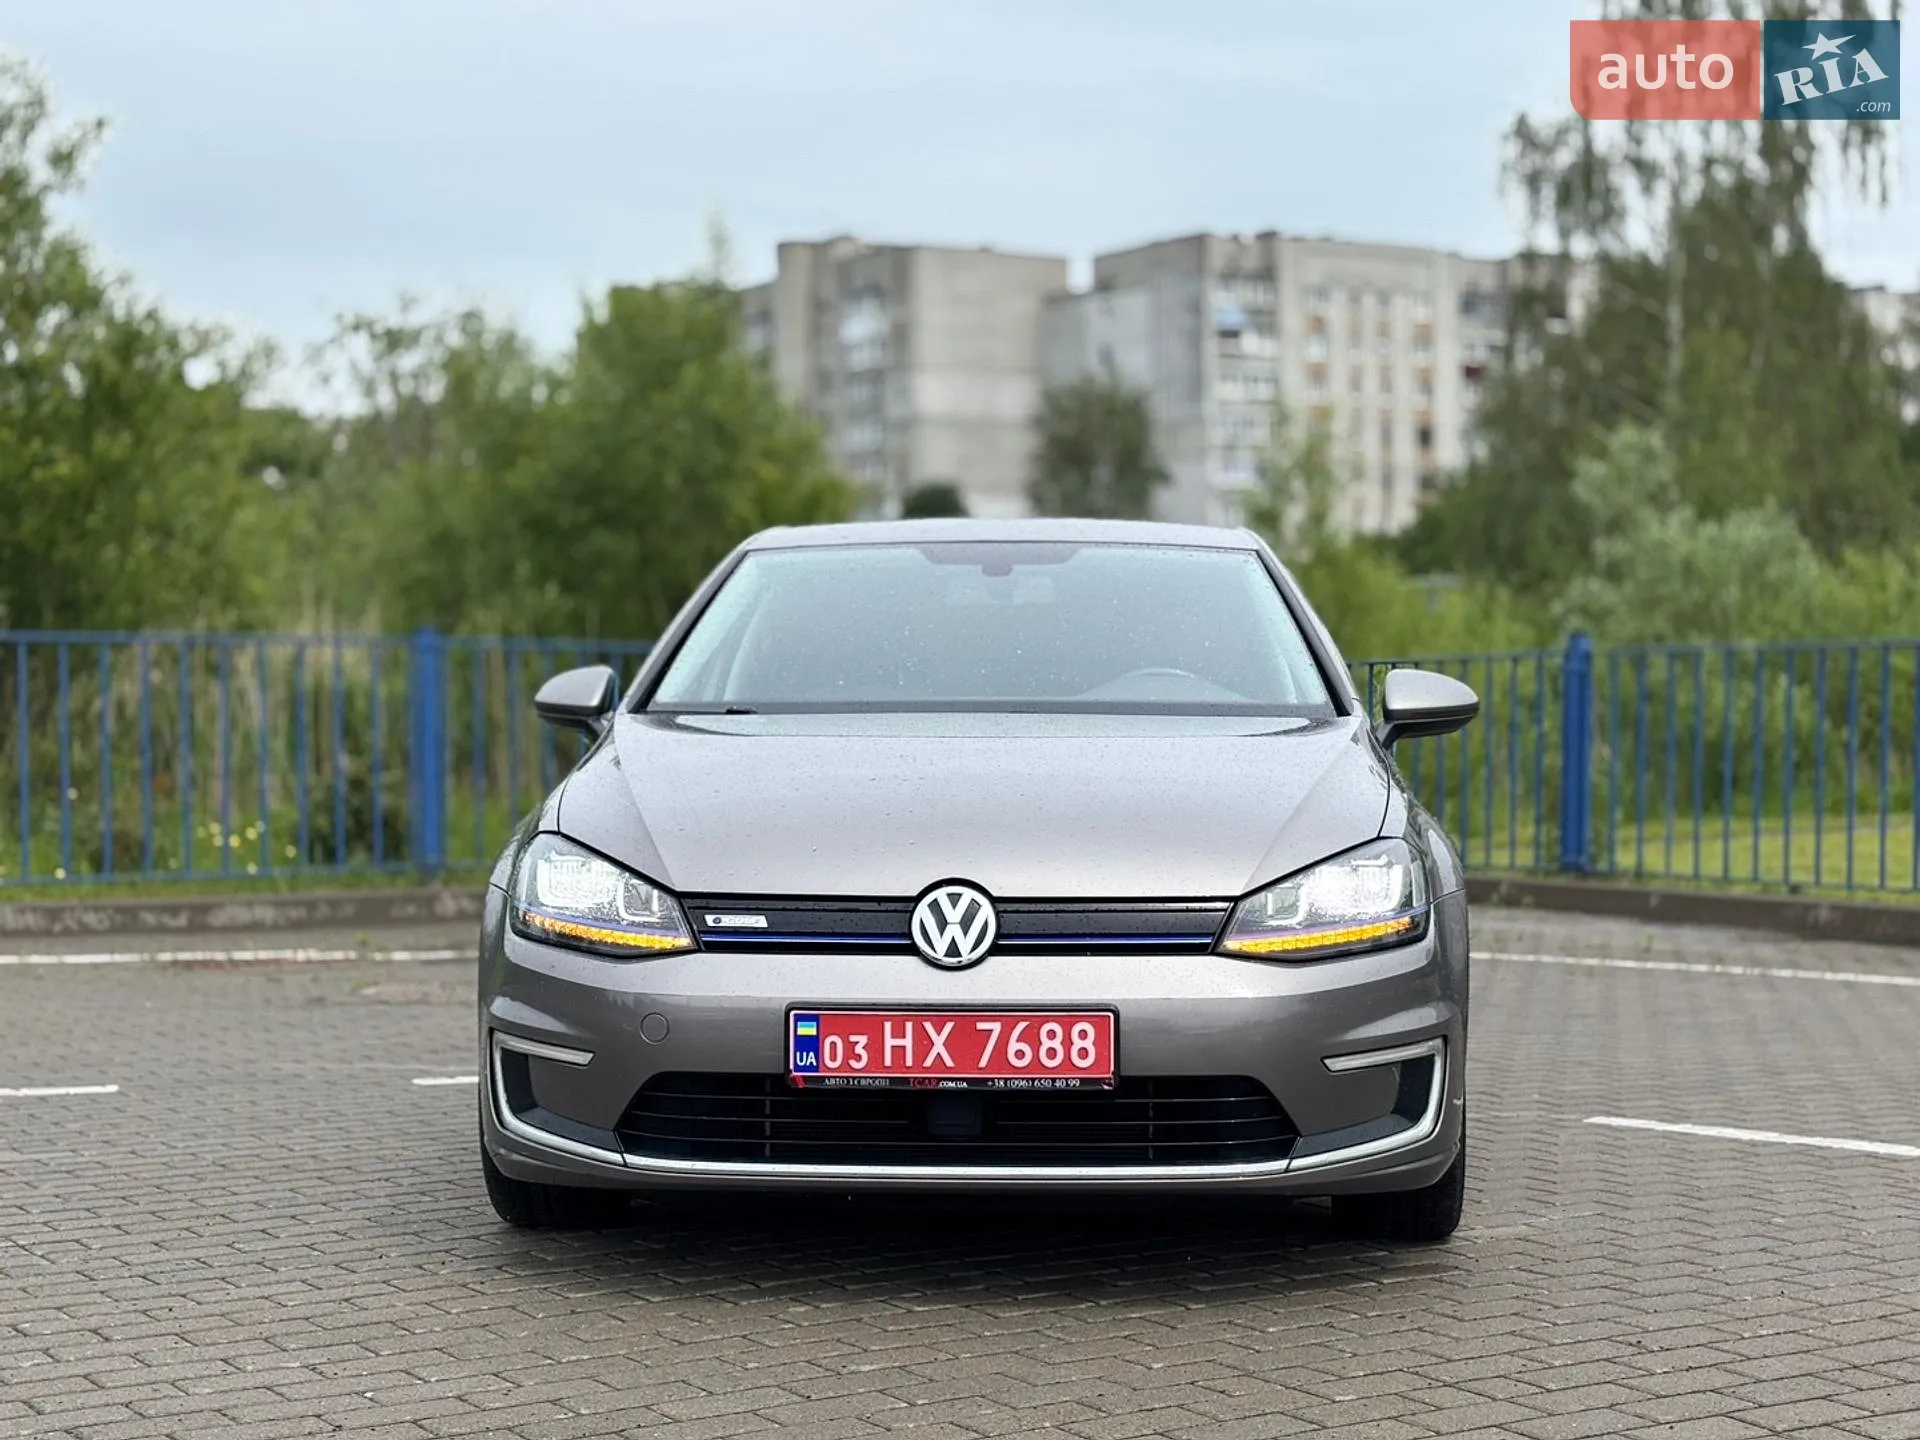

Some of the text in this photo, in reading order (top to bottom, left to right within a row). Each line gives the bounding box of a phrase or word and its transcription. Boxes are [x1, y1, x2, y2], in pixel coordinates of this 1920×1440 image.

[823, 1021, 1096, 1070] 03 HX 7688
[796, 1052, 817, 1066] UA
[1033, 1078, 1052, 1088] 650
[1053, 1078, 1066, 1088] 40
